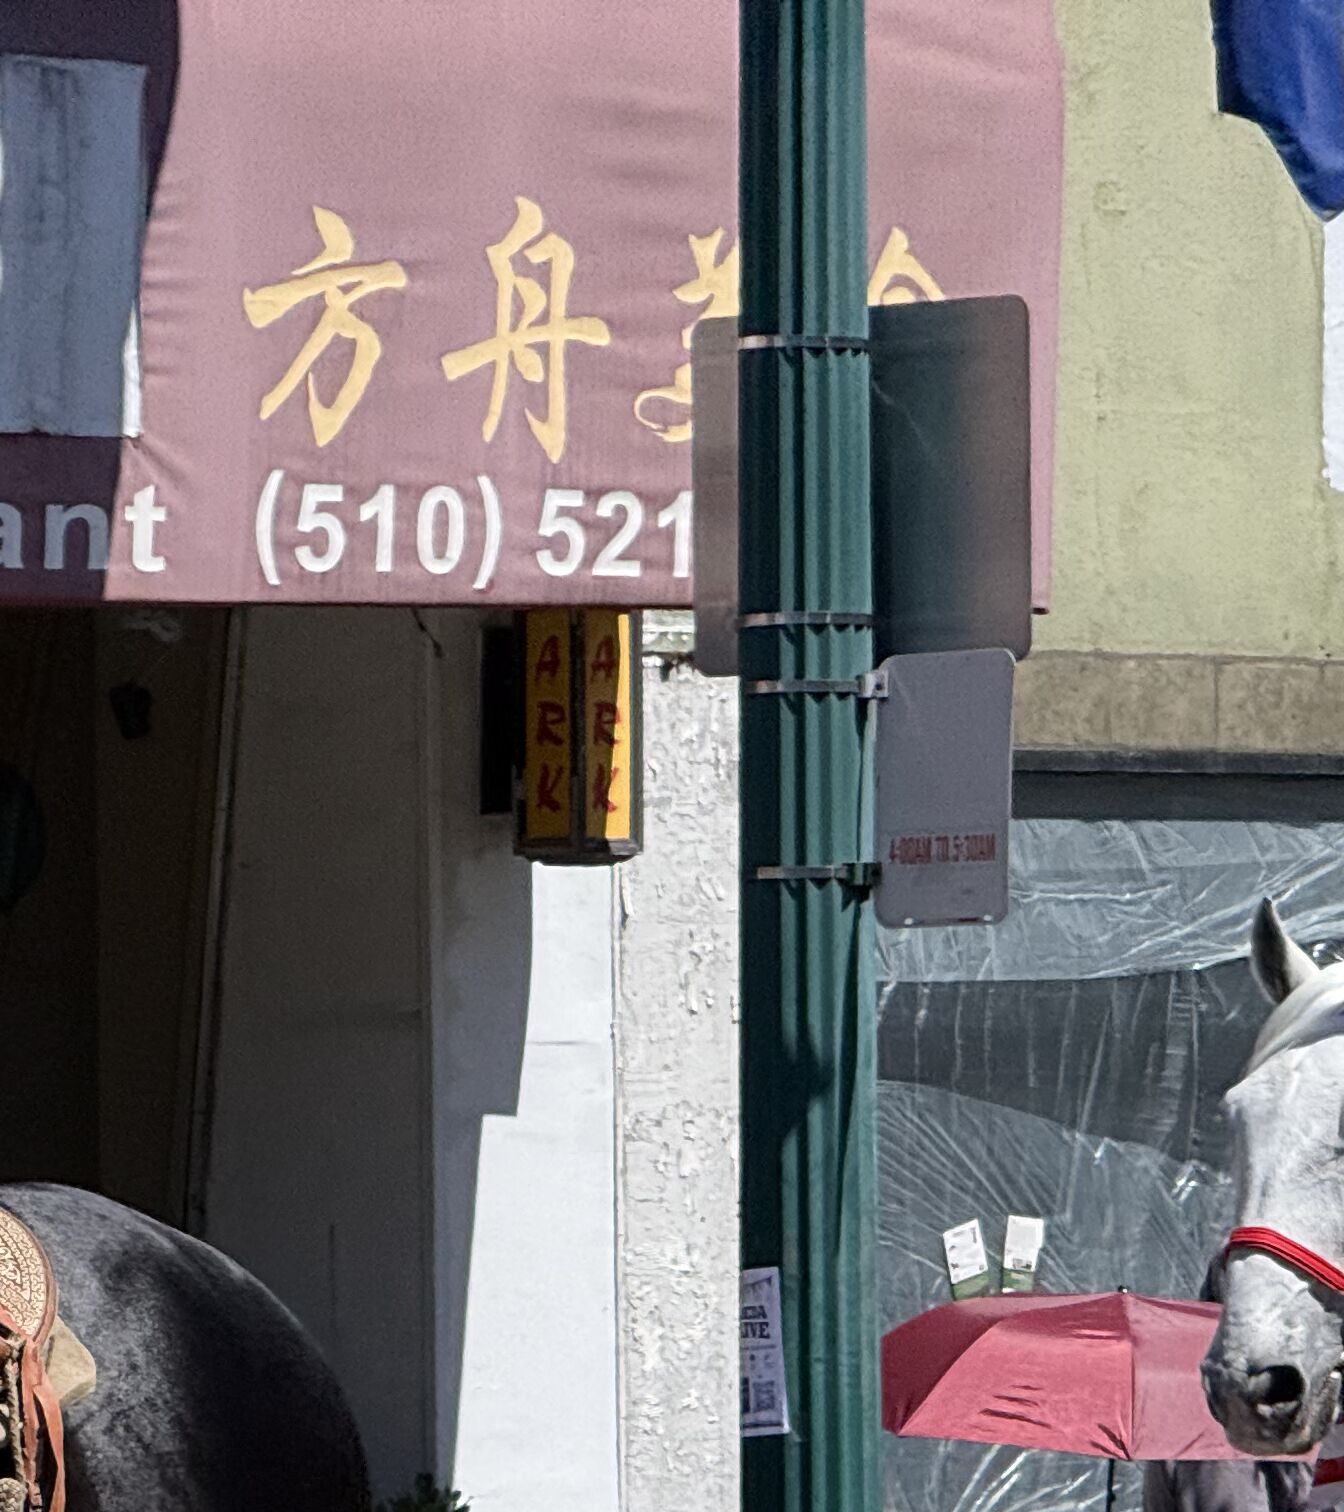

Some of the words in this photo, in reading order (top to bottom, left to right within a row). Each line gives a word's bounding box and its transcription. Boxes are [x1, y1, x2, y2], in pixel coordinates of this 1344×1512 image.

[255, 470, 498, 590] (510)
[535, 634, 567, 813] ARK
[590, 634, 622, 813] ARK
